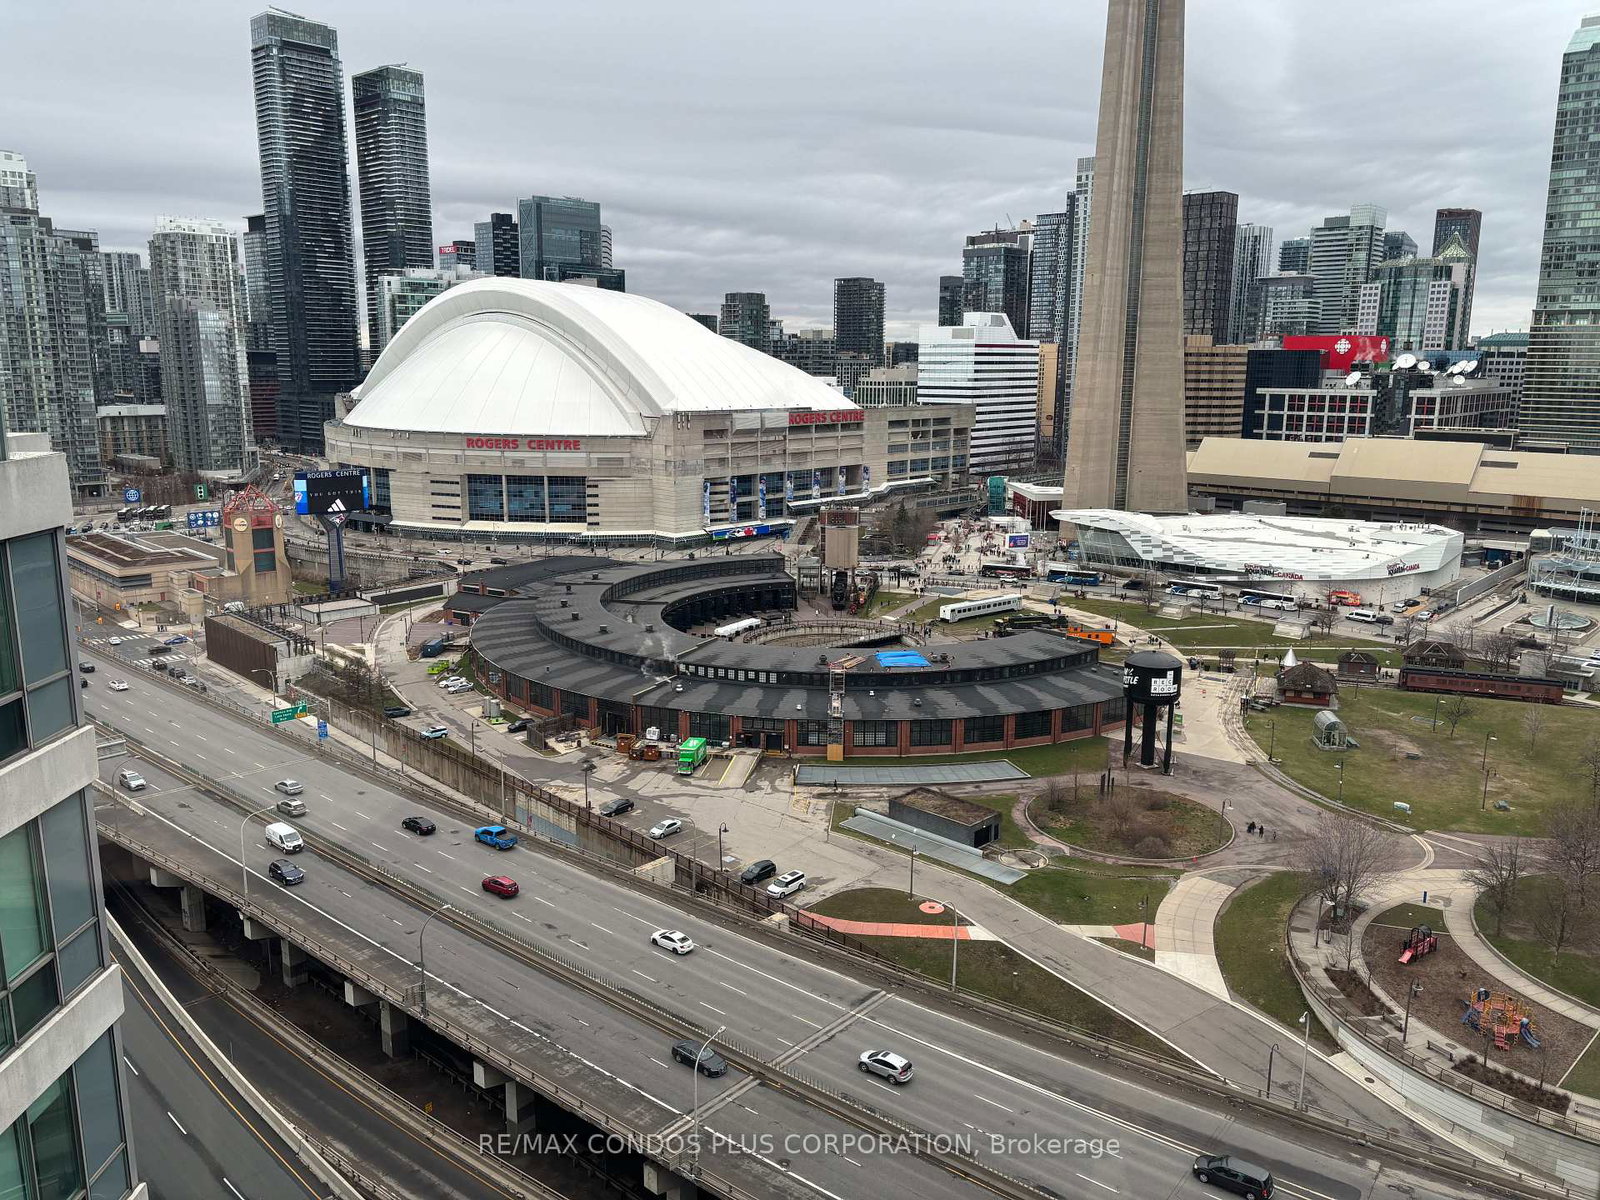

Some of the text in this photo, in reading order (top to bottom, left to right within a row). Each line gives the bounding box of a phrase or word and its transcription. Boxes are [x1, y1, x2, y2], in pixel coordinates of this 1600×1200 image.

[789, 410, 865, 425] ROGERS CENTRE
[466, 438, 581, 450] ROGERS CENTRE
